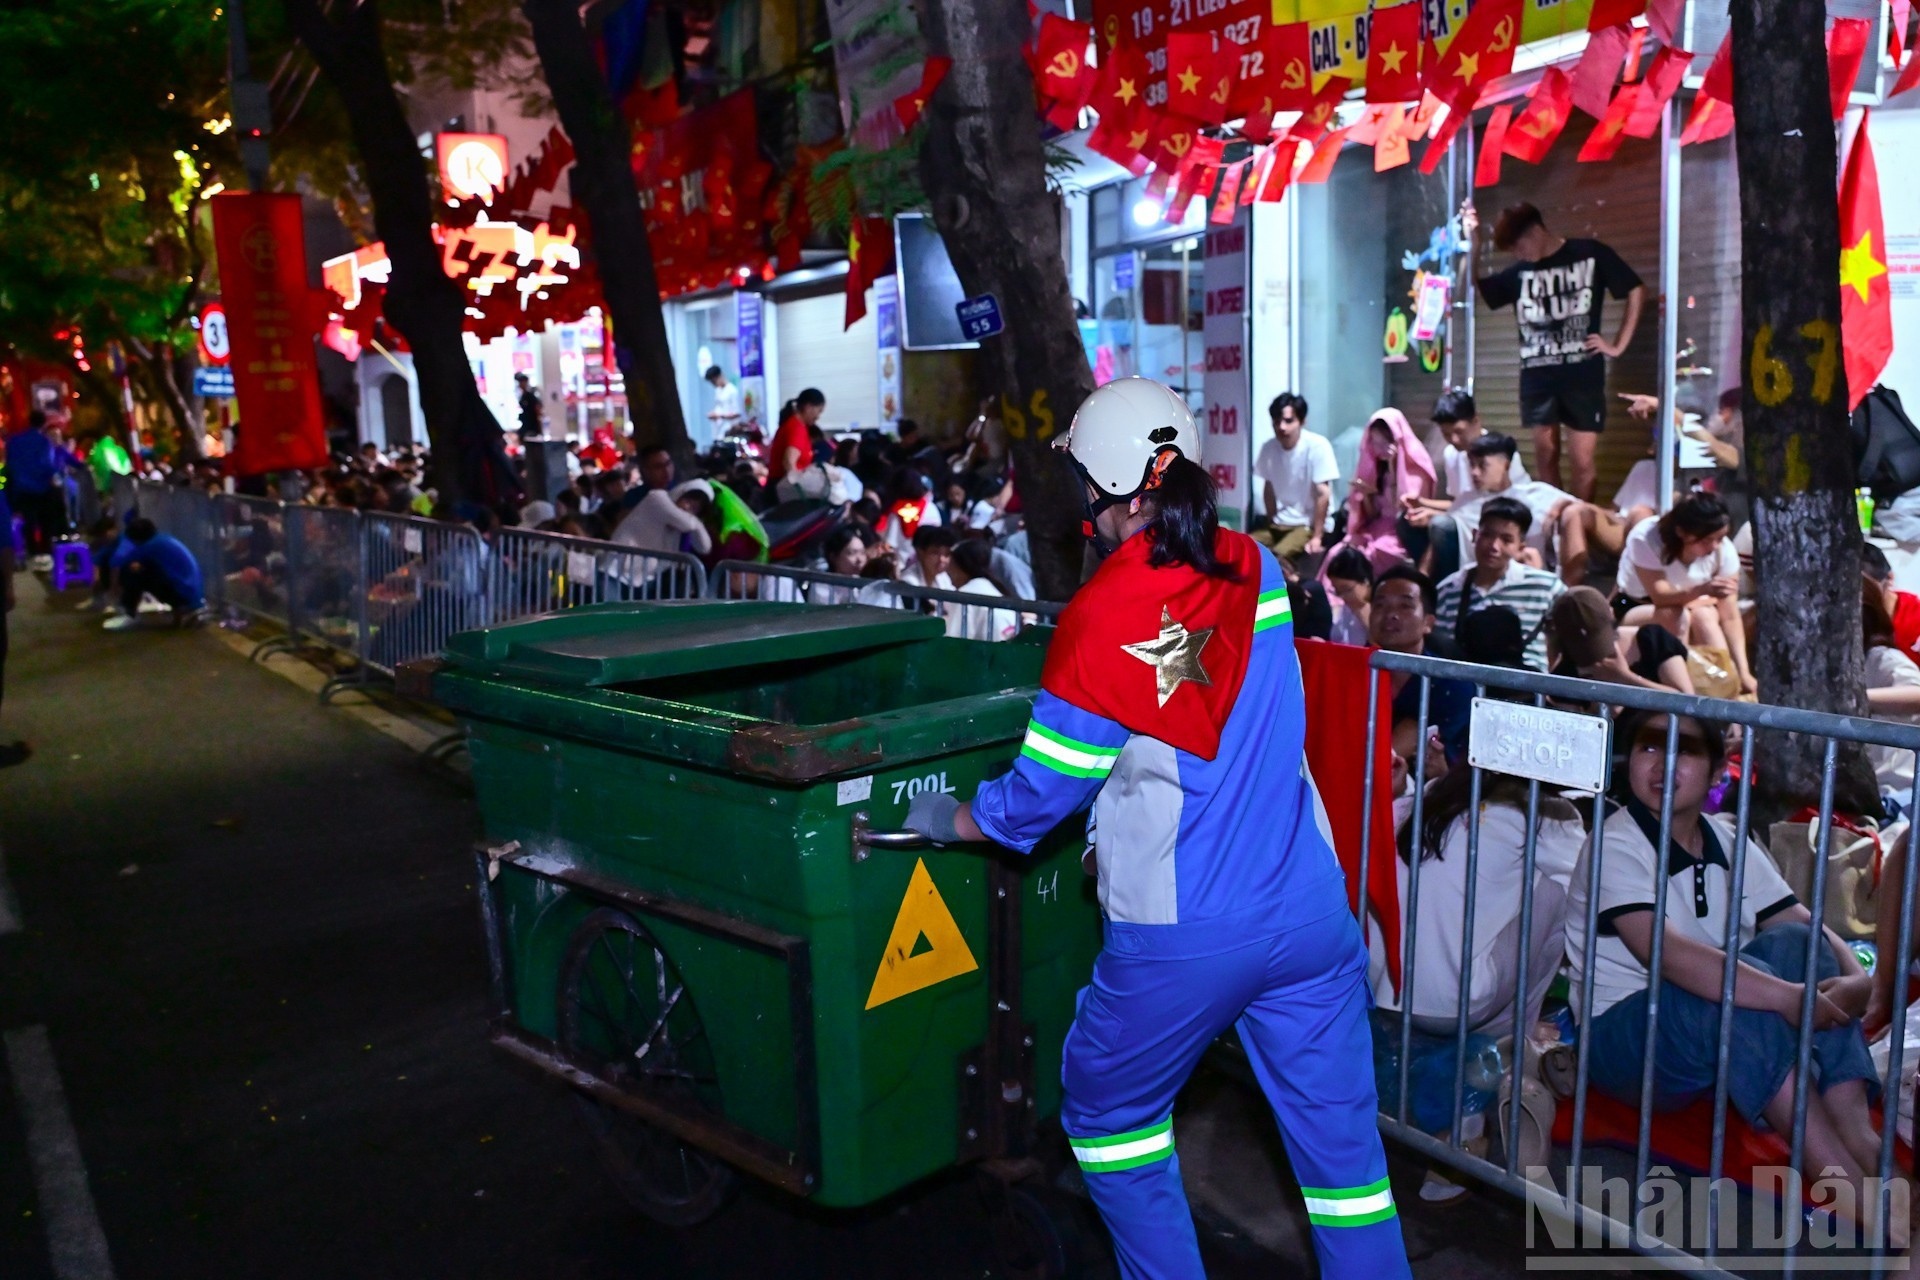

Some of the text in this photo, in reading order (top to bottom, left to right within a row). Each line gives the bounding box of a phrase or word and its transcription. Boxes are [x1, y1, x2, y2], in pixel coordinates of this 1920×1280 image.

[1132, 7, 1154, 38] 19
[1170, 0, 1191, 26] 21
[971, 317, 991, 335] 55
[1751, 319, 1838, 408] 67
[1508, 711, 1563, 733] POLICE
[1496, 731, 1574, 768] STOP
[891, 771, 957, 805] 700L
[1037, 870, 1058, 904] 41
